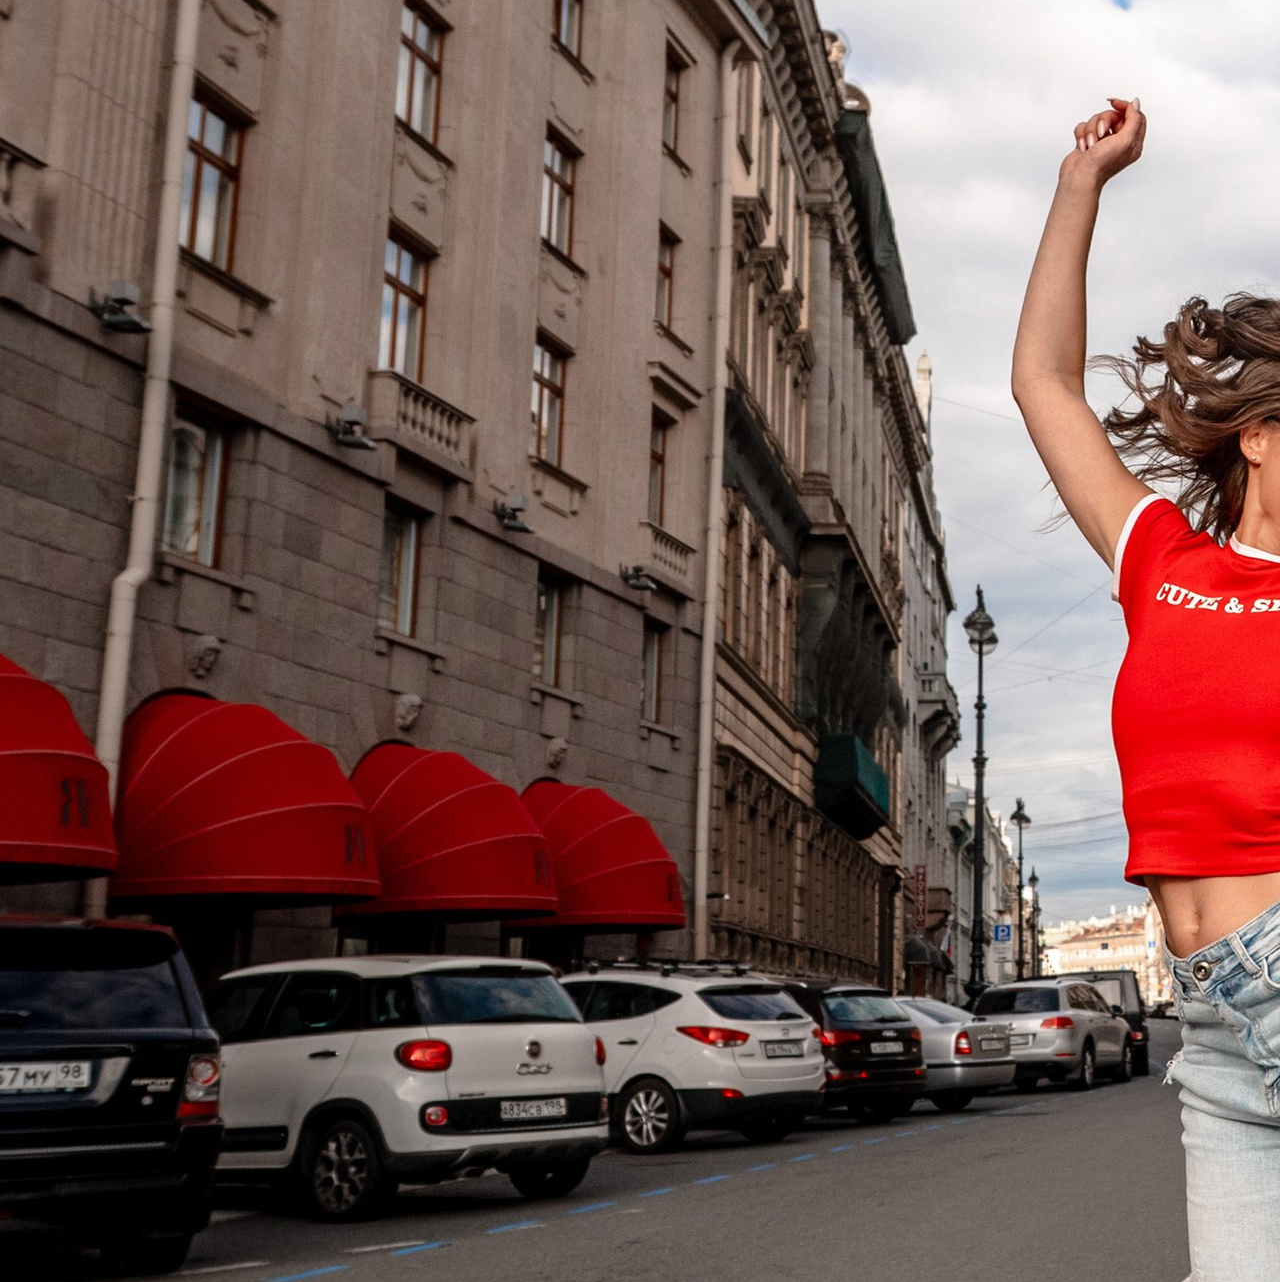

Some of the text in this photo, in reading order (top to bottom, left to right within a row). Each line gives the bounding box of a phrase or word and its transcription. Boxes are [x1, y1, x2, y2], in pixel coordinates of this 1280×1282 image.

[1156, 582, 1223, 611] CUTE
[1224, 597, 1245, 614] &
[60, 1065, 82, 1080] 98
